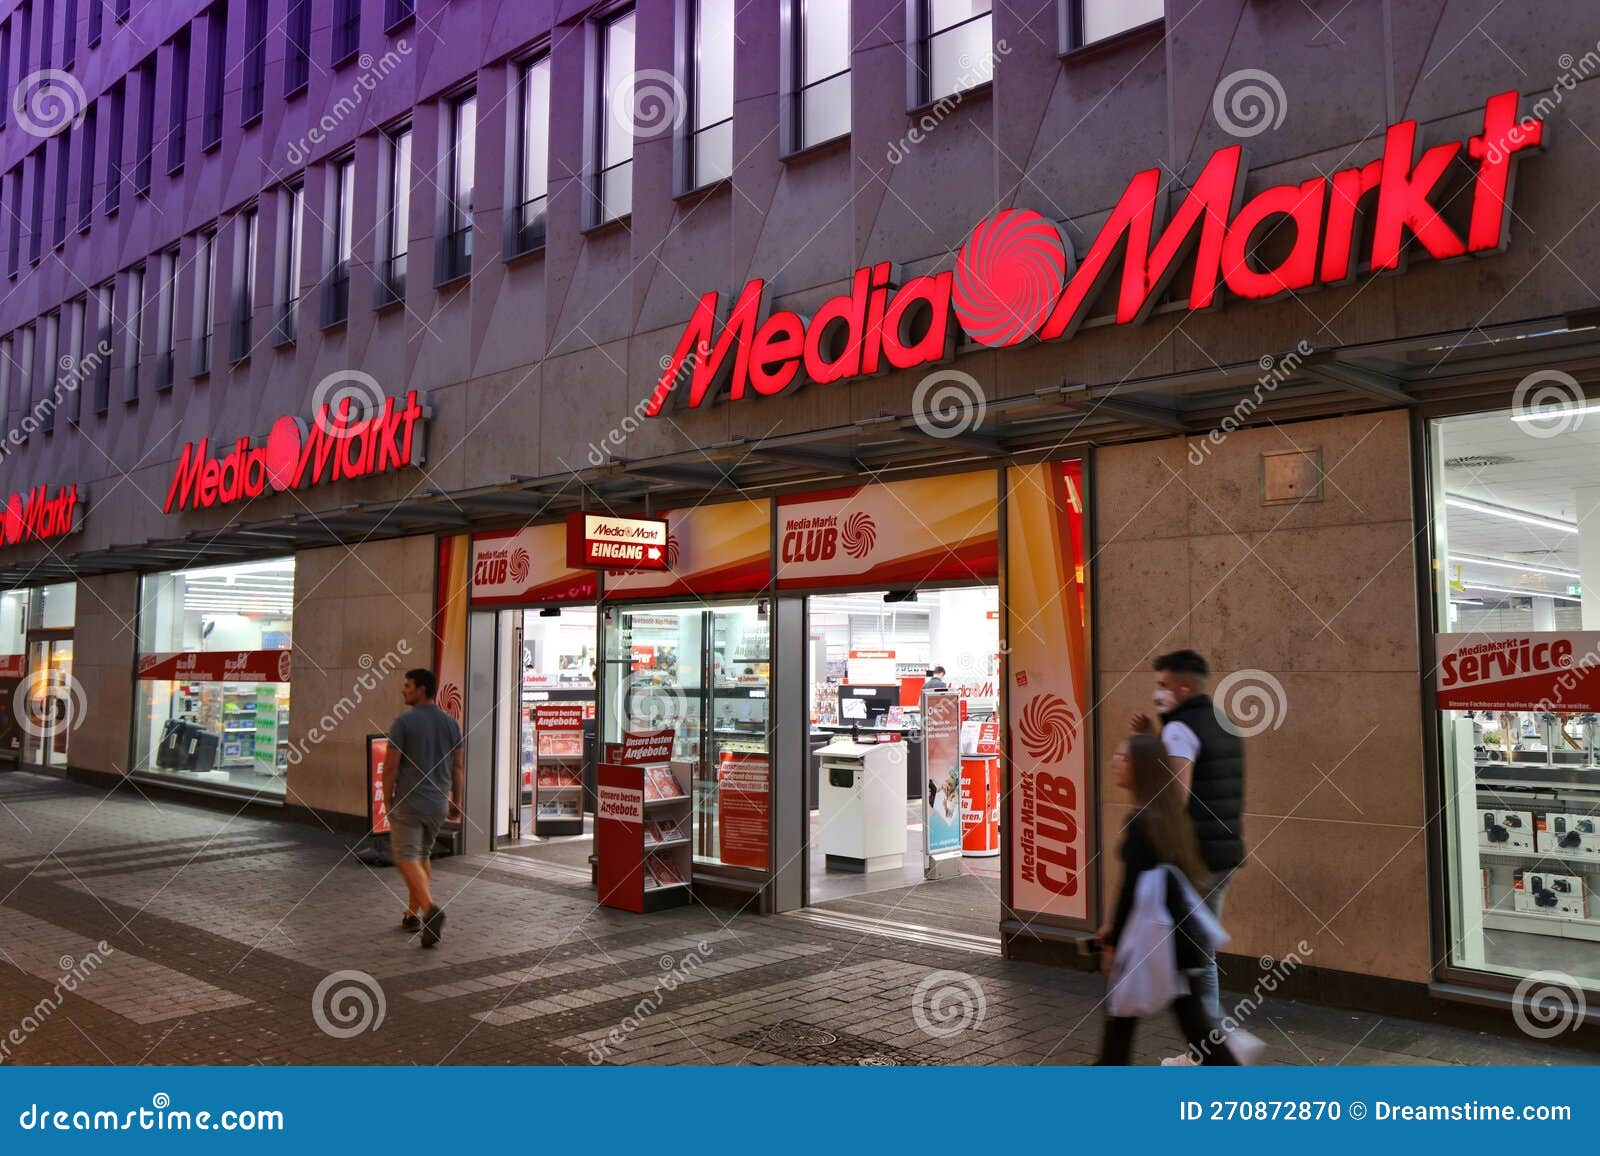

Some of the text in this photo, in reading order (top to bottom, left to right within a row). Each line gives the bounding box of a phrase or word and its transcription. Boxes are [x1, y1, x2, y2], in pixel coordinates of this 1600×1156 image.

[643, 90, 1543, 418] Media Markt
[163, 437, 268, 515] Media
[785, 515, 838, 532] Media Markt
[591, 542, 643, 560] EINGANG
[782, 527, 838, 564] CLUB
[474, 557, 508, 586] CLUB
[1458, 638, 1518, 657] MediaMarkt
[1441, 638, 1573, 687] Service
[537, 717, 580, 727] Angebote.
[625, 735, 673, 747] Unsere besten
[624, 745, 669, 760] Angebote.
[600, 790, 641, 804] Unsere besten
[600, 801, 640, 817] Angebote.
[1020, 770, 1035, 884] Media Markt
[1036, 771, 1078, 897] CLUB
